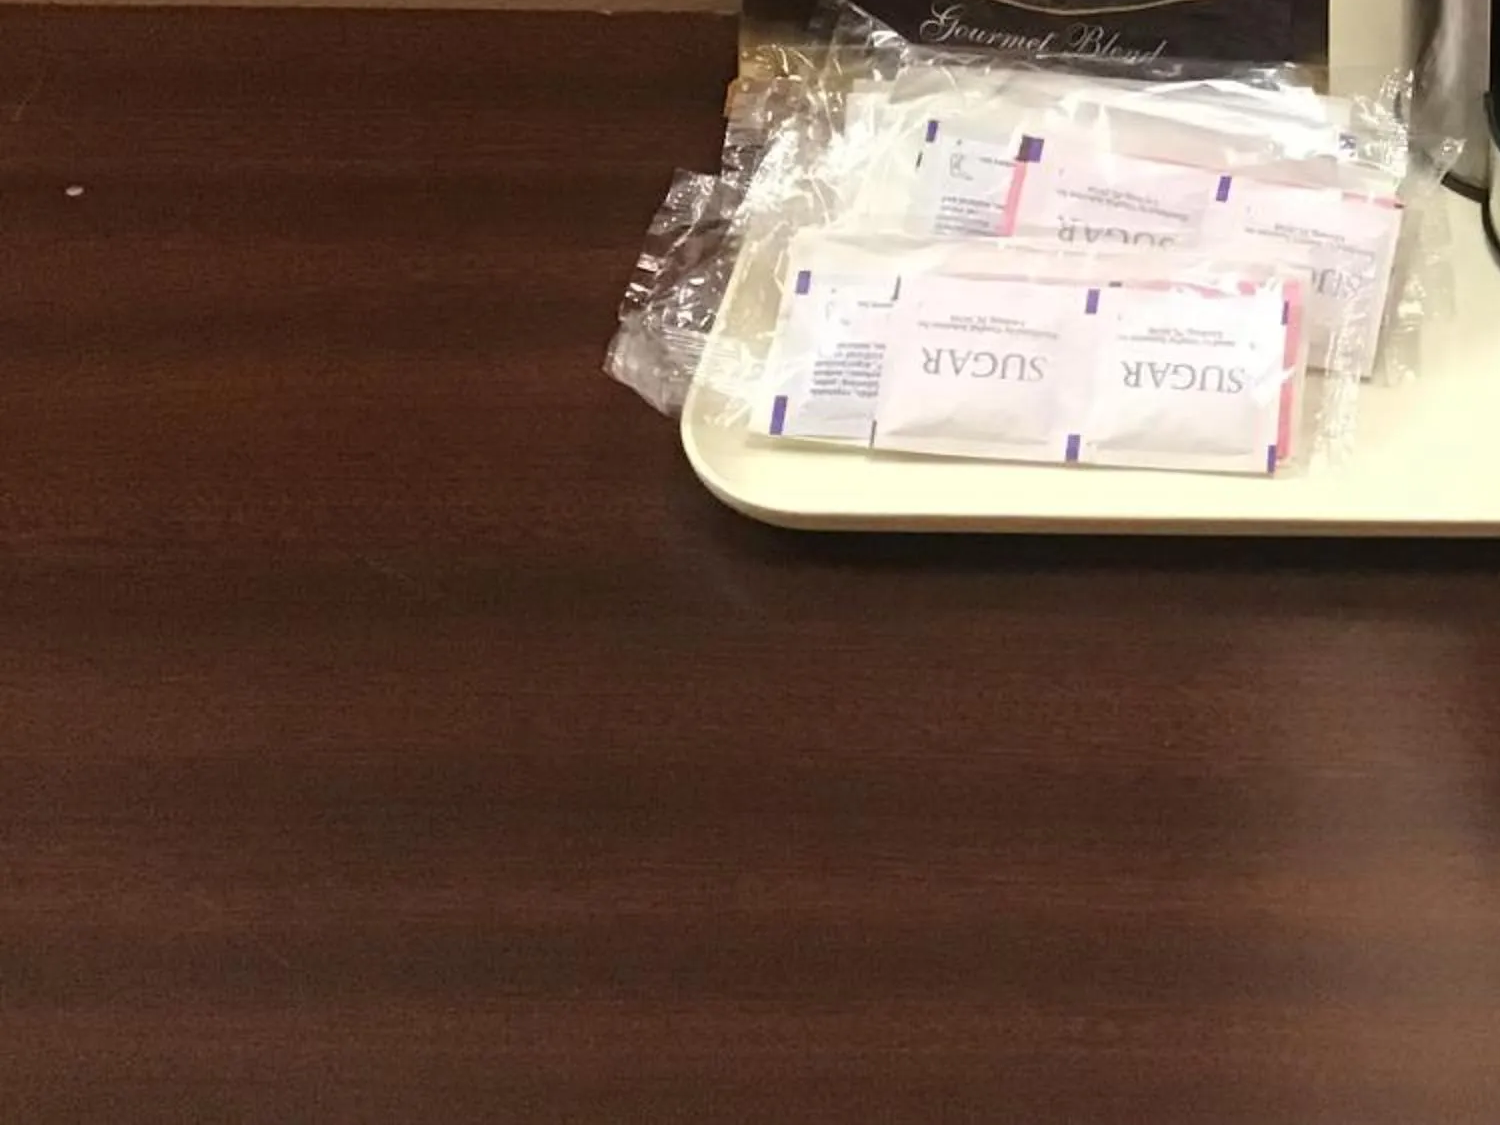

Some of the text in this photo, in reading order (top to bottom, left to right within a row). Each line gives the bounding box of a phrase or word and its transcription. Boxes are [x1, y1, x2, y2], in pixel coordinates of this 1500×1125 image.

[919, 2, 1168, 65] Gourmet Blend
[921, 346, 1049, 383] SUGAR
[1119, 360, 1246, 395] SUGAR
